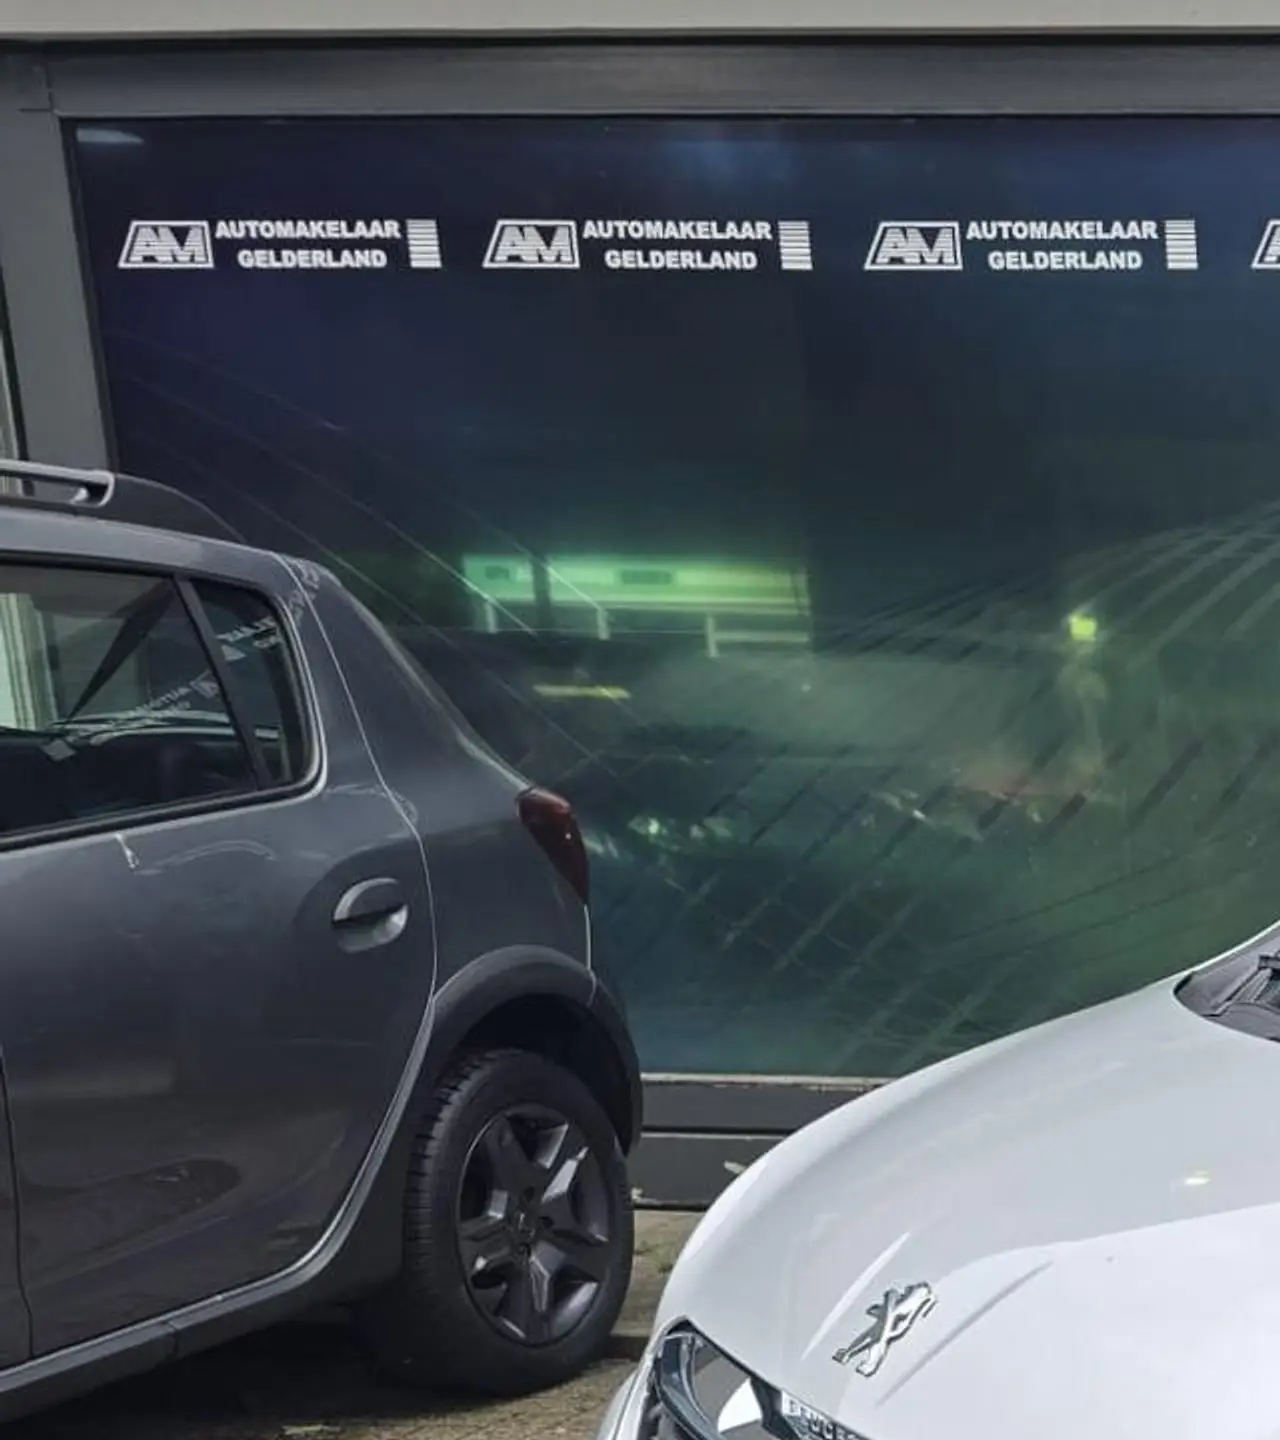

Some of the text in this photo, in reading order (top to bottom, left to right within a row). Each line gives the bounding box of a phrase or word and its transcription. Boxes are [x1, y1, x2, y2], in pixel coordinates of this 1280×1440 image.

[215, 219, 402, 239] AUTOMAKELAAR
[583, 219, 773, 240] AUTOMAKELAAR
[966, 220, 1159, 241] AUTOMAKELAAR
[128, 225, 207, 263] AM
[493, 225, 573, 263] AM
[874, 225, 957, 265] AM
[237, 249, 388, 269] GELDERLAND
[604, 250, 758, 271] GELDERLAND
[987, 250, 1144, 271] GELDERLAND
